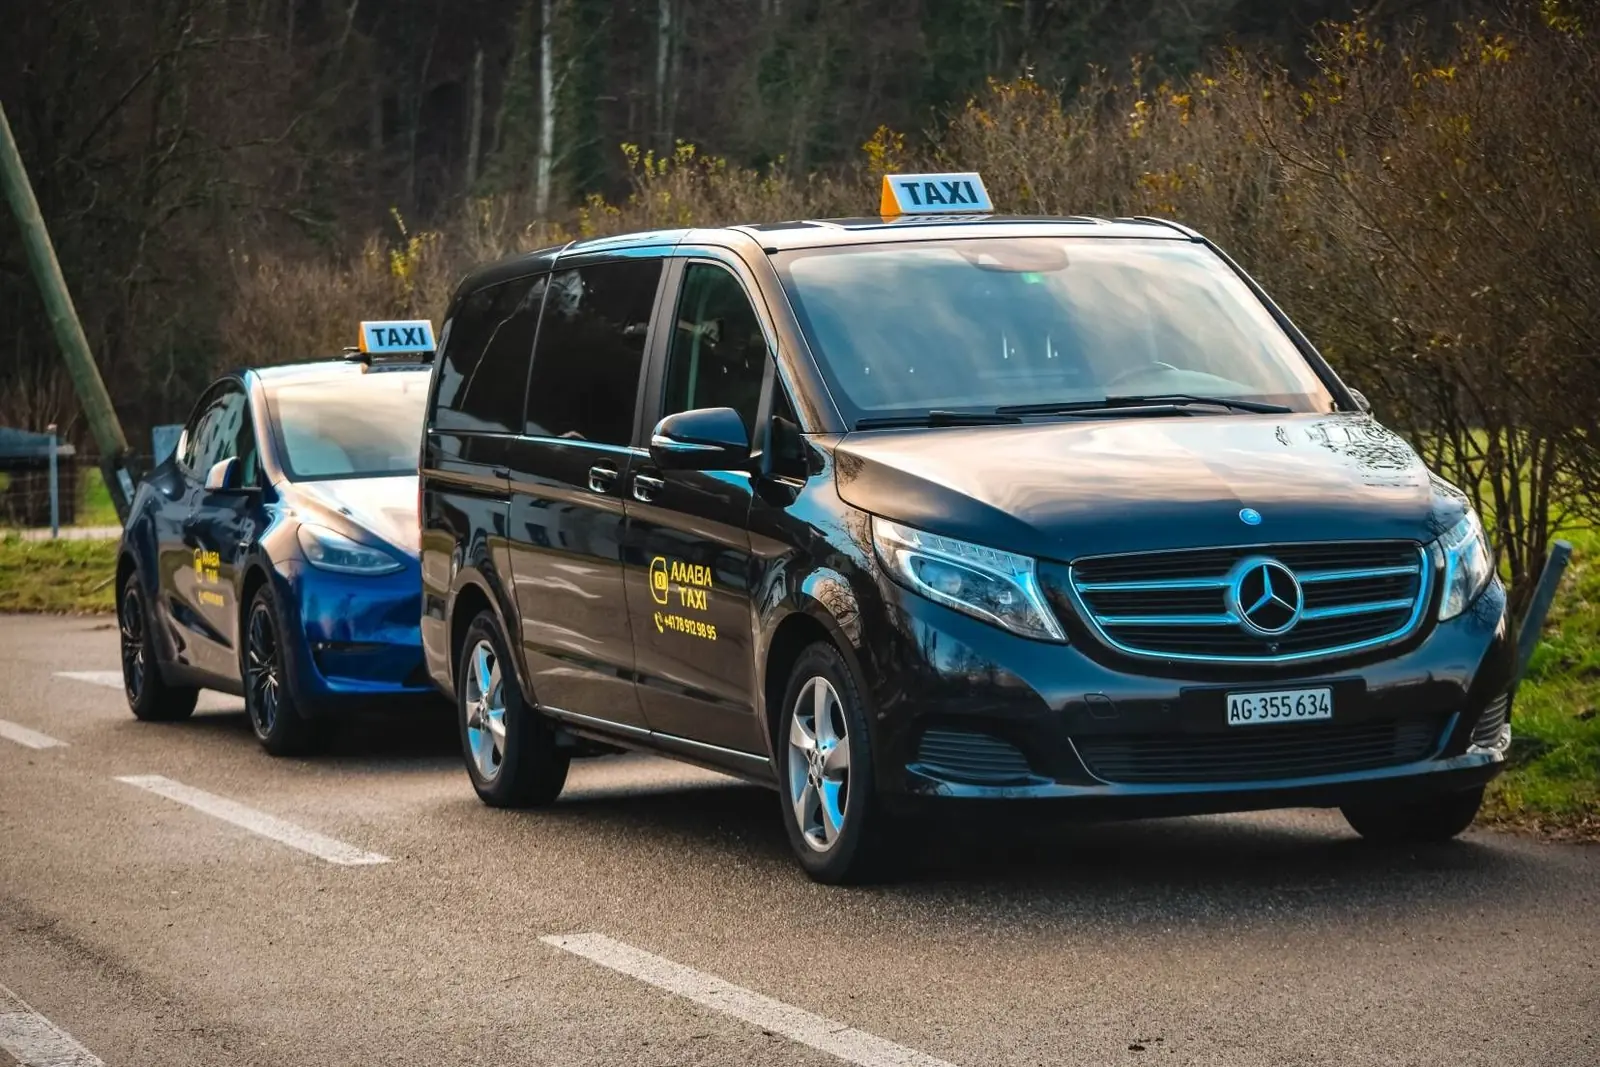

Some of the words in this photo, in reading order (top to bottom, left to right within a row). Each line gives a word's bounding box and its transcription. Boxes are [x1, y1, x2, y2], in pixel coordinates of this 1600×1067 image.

[900, 181, 979, 206] TAXI
[371, 327, 426, 347] TAXI
[670, 561, 713, 588] AAABA
[678, 586, 708, 611] TAXI
[1295, 693, 1329, 716] 634
